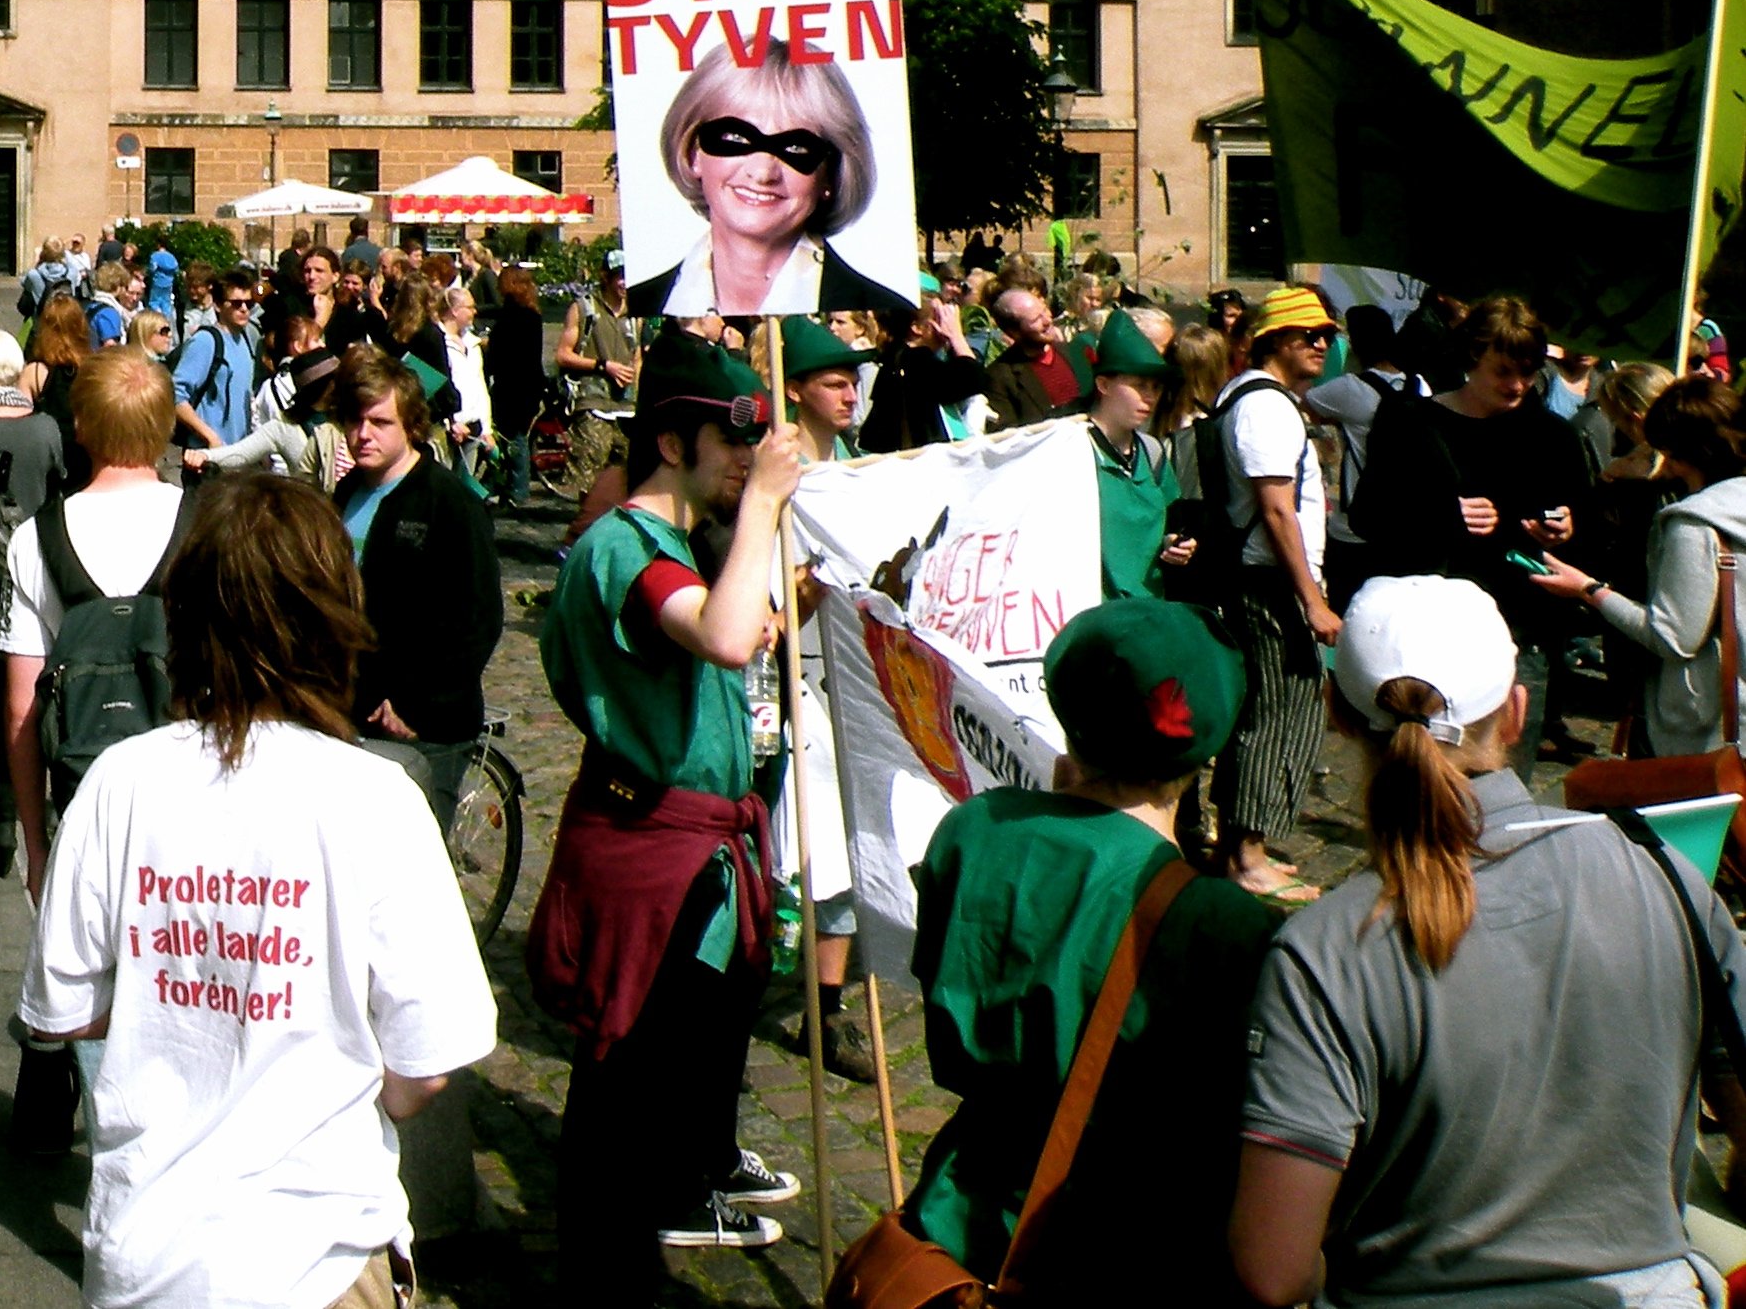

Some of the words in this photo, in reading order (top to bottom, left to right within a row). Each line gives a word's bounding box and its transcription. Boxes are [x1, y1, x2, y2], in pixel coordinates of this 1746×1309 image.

[138, 865, 311, 908] Proletarer
[128, 925, 141, 958] i
[152, 920, 209, 957] alle
